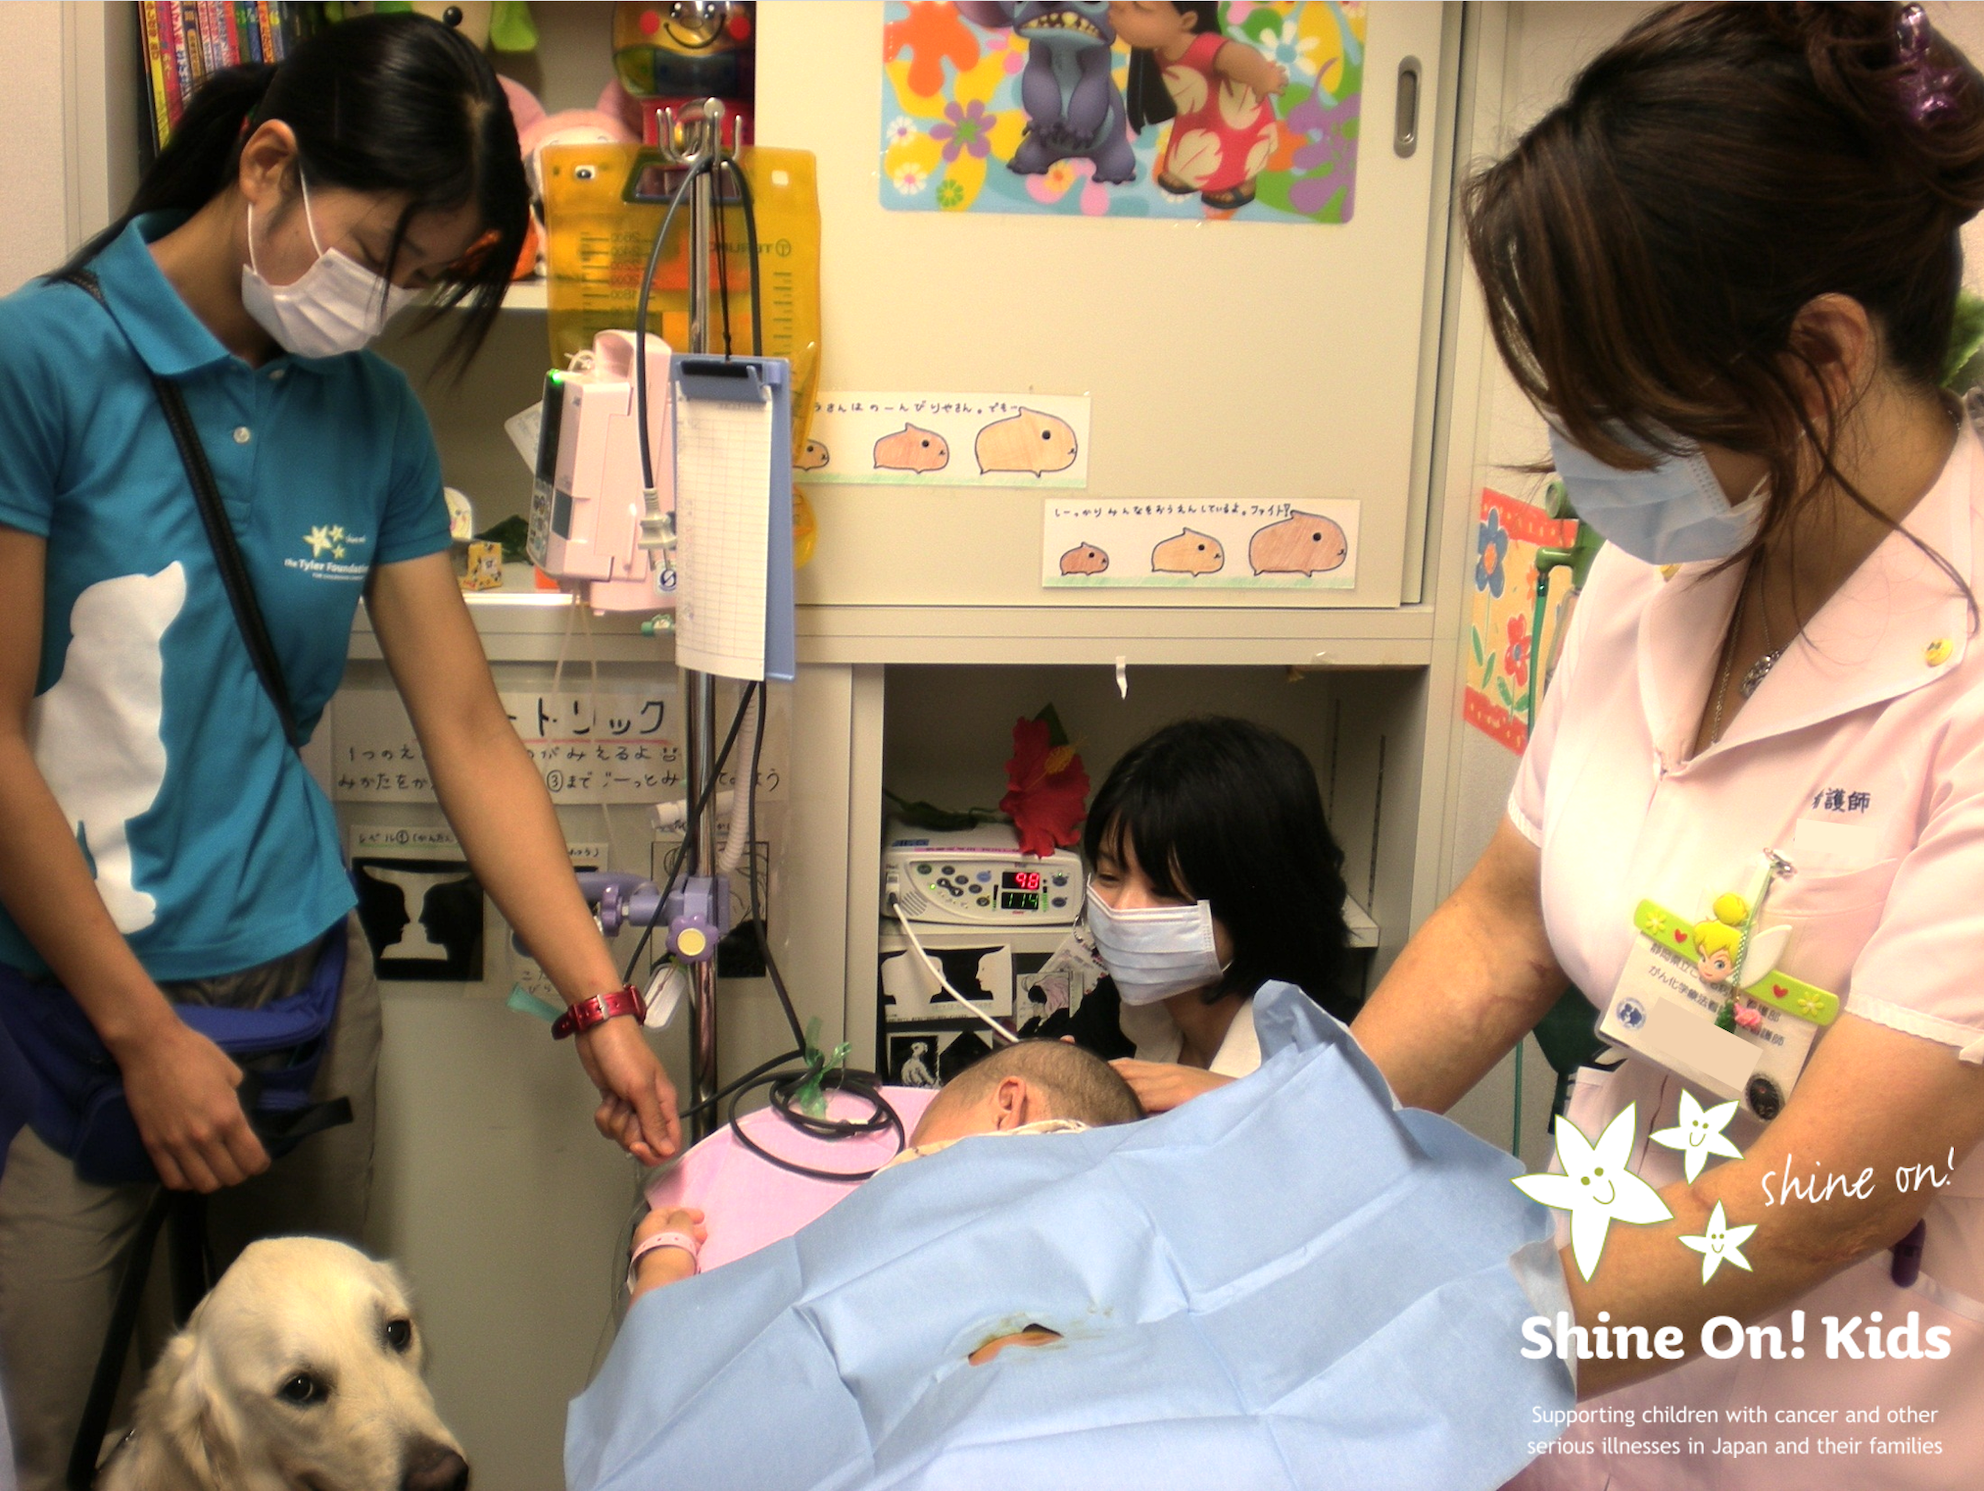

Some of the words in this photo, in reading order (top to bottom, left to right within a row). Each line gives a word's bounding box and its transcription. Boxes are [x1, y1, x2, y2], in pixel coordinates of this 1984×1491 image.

[299, 558, 325, 572] Tyler
[1015, 872, 1040, 889] 98
[1008, 893, 1039, 909] 114
